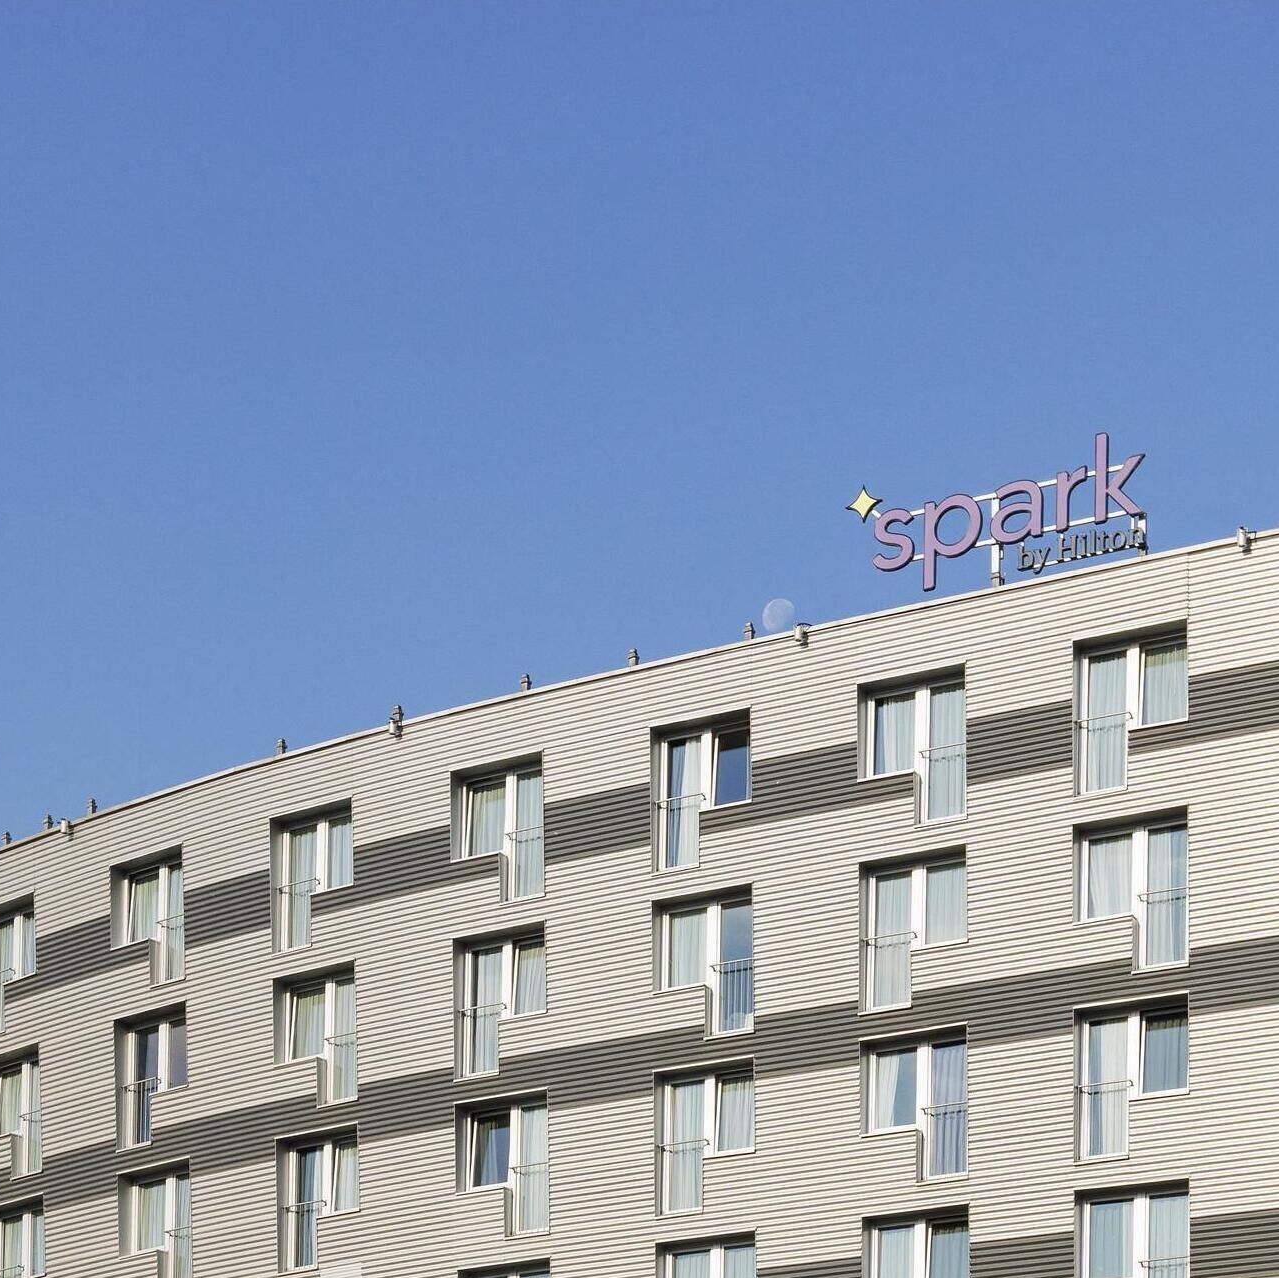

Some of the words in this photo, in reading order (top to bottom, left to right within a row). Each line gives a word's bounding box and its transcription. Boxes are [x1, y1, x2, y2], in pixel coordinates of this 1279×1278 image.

[872, 432, 1146, 590] spark
[1017, 541, 1051, 574] by
[1057, 527, 1146, 562] Hilton
